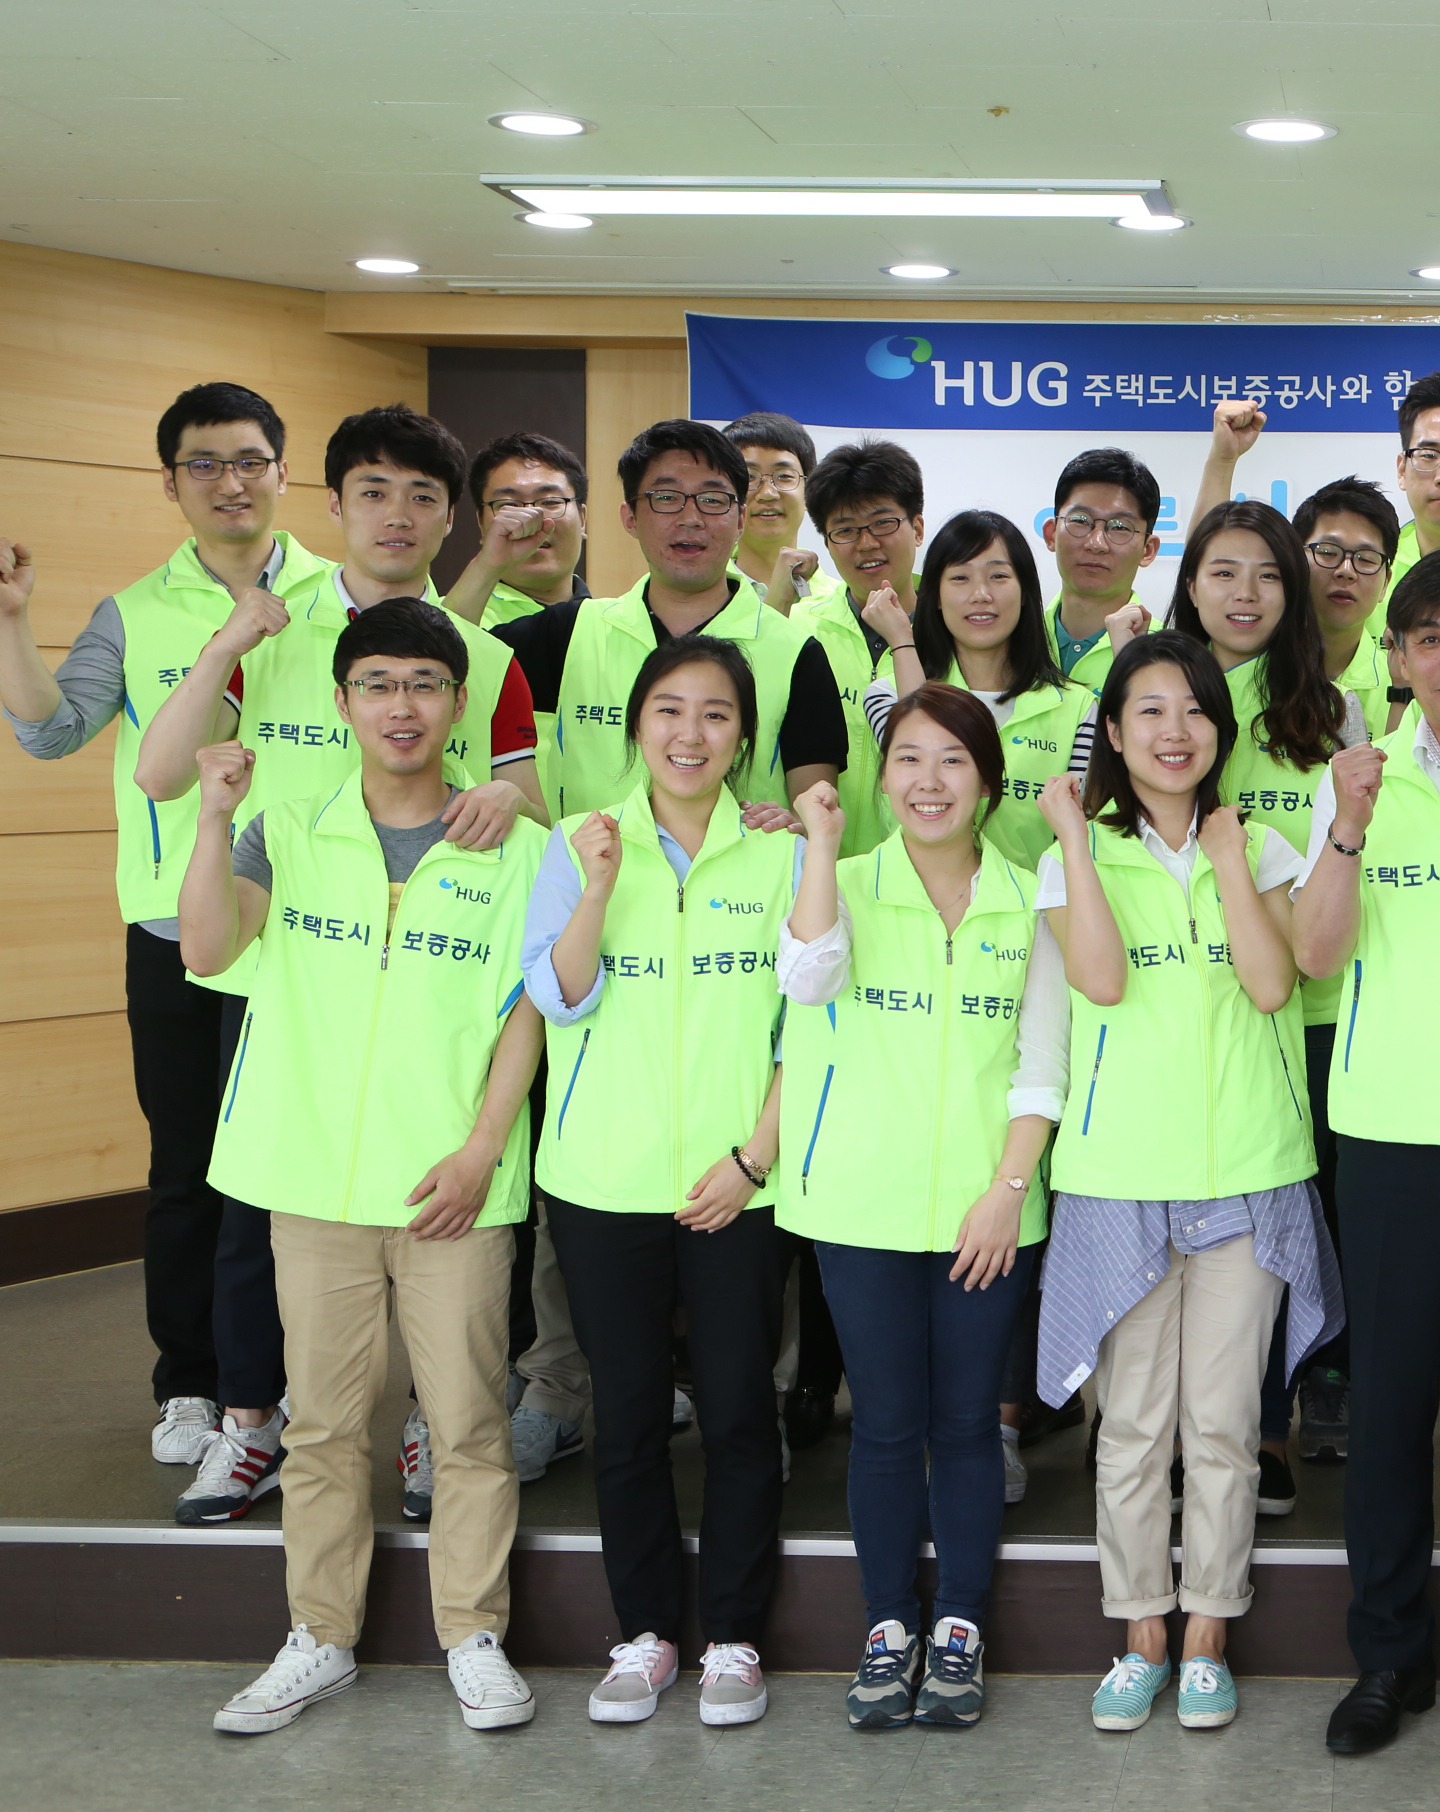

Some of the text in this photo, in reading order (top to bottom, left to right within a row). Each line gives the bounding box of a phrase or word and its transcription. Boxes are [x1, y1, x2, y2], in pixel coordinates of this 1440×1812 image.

[931, 361, 1068, 406] HUG
[1083, 373, 1372, 408] 주택도시보증공사와
[575, 705, 623, 726] 주택도
[257, 721, 349, 750] 주택도시
[1028, 739, 1057, 753] HUG
[455, 885, 492, 905] HUG
[728, 902, 764, 915] HUG
[283, 906, 491, 965] 주택도시 보증공사
[600, 951, 778, 979] 택도시 보증공사
[995, 947, 1027, 962] HUG
[855, 984, 933, 1015] 택도시
